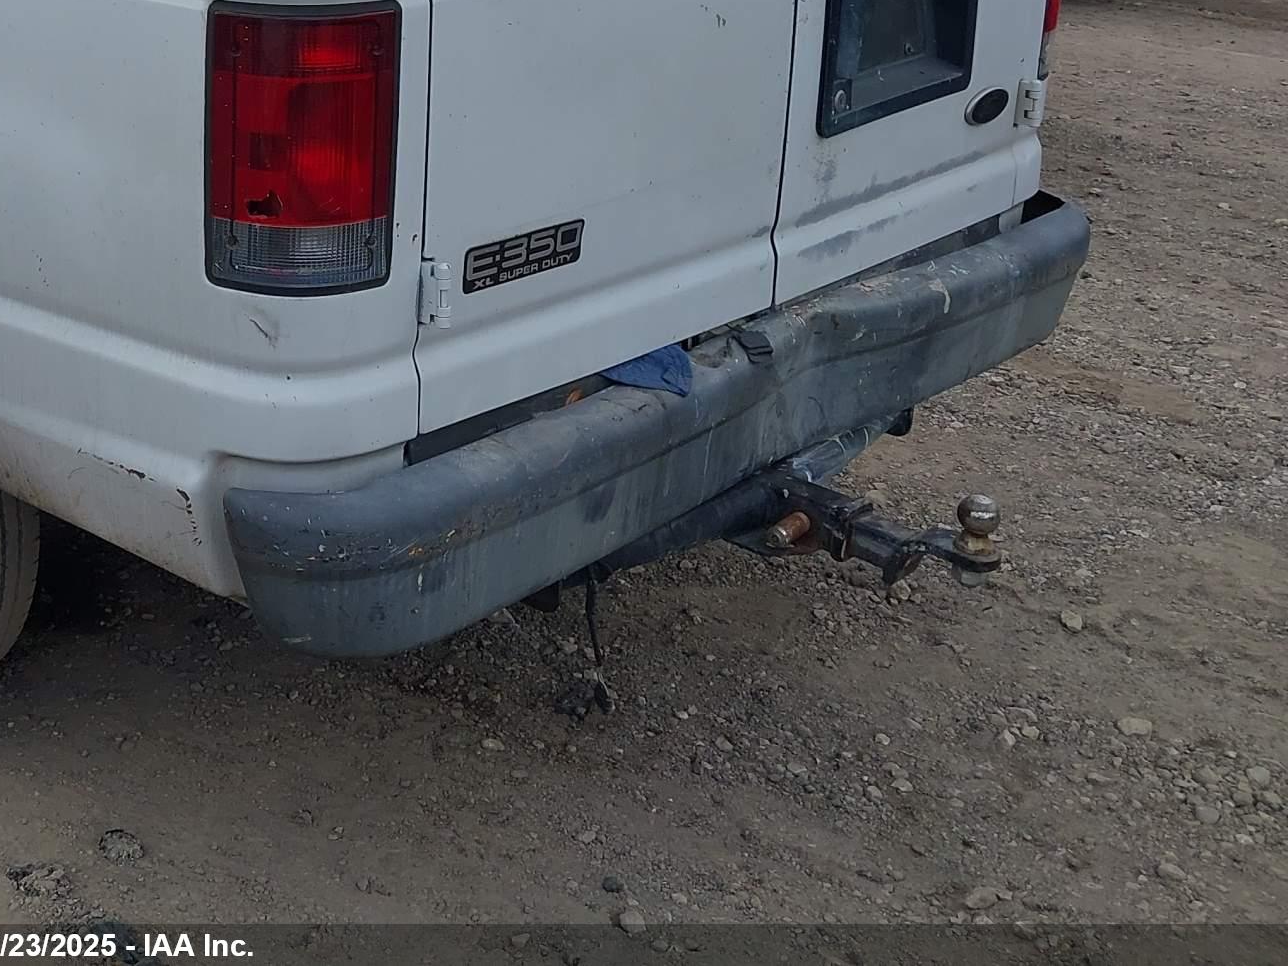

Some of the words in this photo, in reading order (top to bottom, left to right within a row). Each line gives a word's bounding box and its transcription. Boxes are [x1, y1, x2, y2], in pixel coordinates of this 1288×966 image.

[473, 277, 495, 290] XL
[499, 262, 539, 281] SUPER
[542, 252, 573, 268] DUTY
